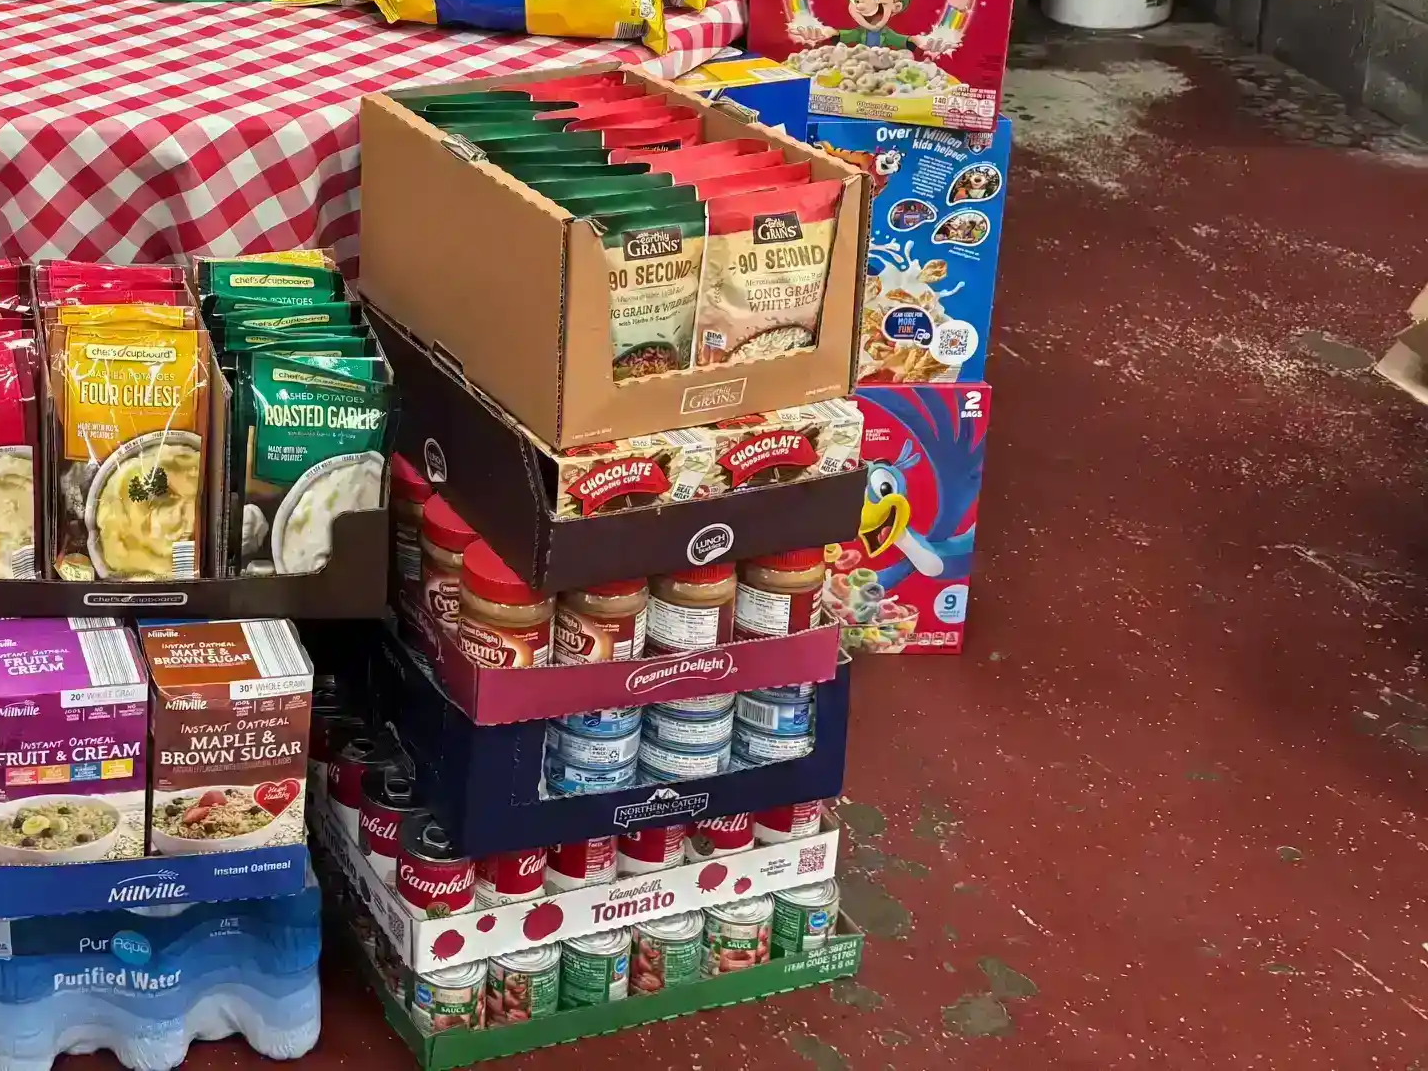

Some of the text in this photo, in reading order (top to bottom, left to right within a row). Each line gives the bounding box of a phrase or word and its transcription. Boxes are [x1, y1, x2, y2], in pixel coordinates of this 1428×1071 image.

[877, 127, 912, 142] Over
[922, 128, 962, 148] Million
[912, 139, 967, 162] kids helped!
[627, 238, 679, 257] GRAINS
[640, 231, 669, 245] earthly
[738, 245, 825, 273] 90 SECOND
[747, 282, 821, 302] LONG GRAIN
[749, 293, 819, 311] WHITE RICE
[80, 383, 181, 407] FOUR CHEESE
[965, 390, 981, 410] 2
[265, 404, 381, 430] ROASTED GARLIC
[729, 436, 802, 468] CHOCOLATE
[579, 463, 652, 496] CHOCOLATE
[694, 531, 726, 552] LUNCH
[944, 593, 959, 611] 9
[8, 662, 65, 675] CREAM
[154, 652, 252, 665] BROWN SUGAR
[634, 659, 724, 688] Peanut Delight
[56, 750, 67, 761] &
[72, 743, 141, 761] CREAM
[160, 740, 302, 766] BROWN SUGAR
[621, 798, 701, 817] NORTHERN CATCH
[214, 860, 291, 877] Instant Oatmeal
[108, 882, 186, 903] Millville
[609, 879, 662, 901] Campbell's
[591, 890, 675, 923] Tomato
[79, 936, 110, 953] Pur
[113, 937, 150, 955] Aqua
[53, 969, 182, 991] Purified Water
[441, 1005, 471, 1014] SAUCE
